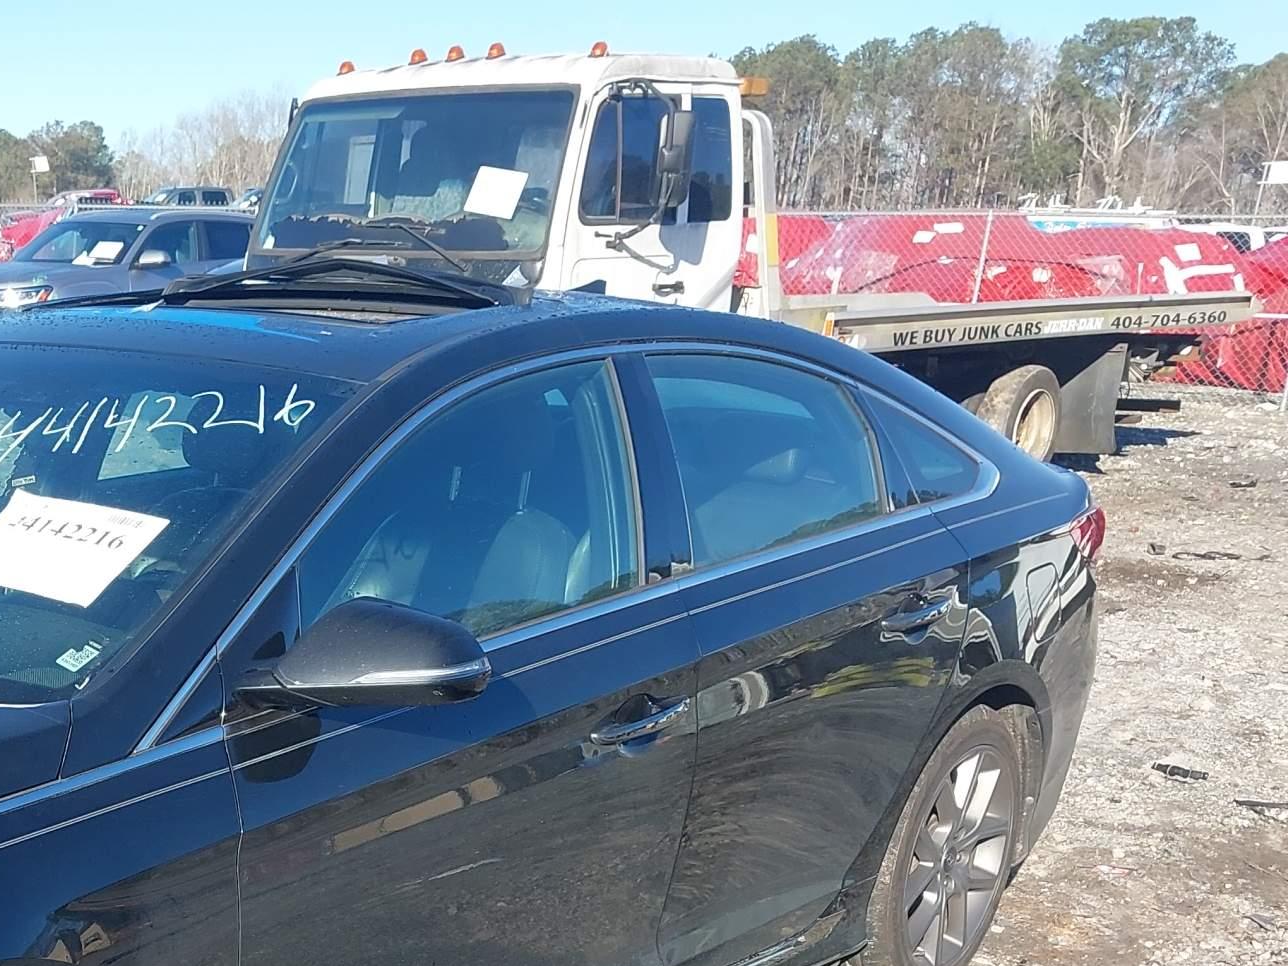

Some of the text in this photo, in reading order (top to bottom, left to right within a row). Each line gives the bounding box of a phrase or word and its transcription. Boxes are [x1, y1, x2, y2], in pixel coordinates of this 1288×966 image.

[893, 330, 919, 347] WE
[922, 327, 957, 345] BUY
[958, 324, 1001, 342] JUNK
[1004, 320, 1043, 338] CARS
[1110, 310, 1227, 330] 404-704-6360
